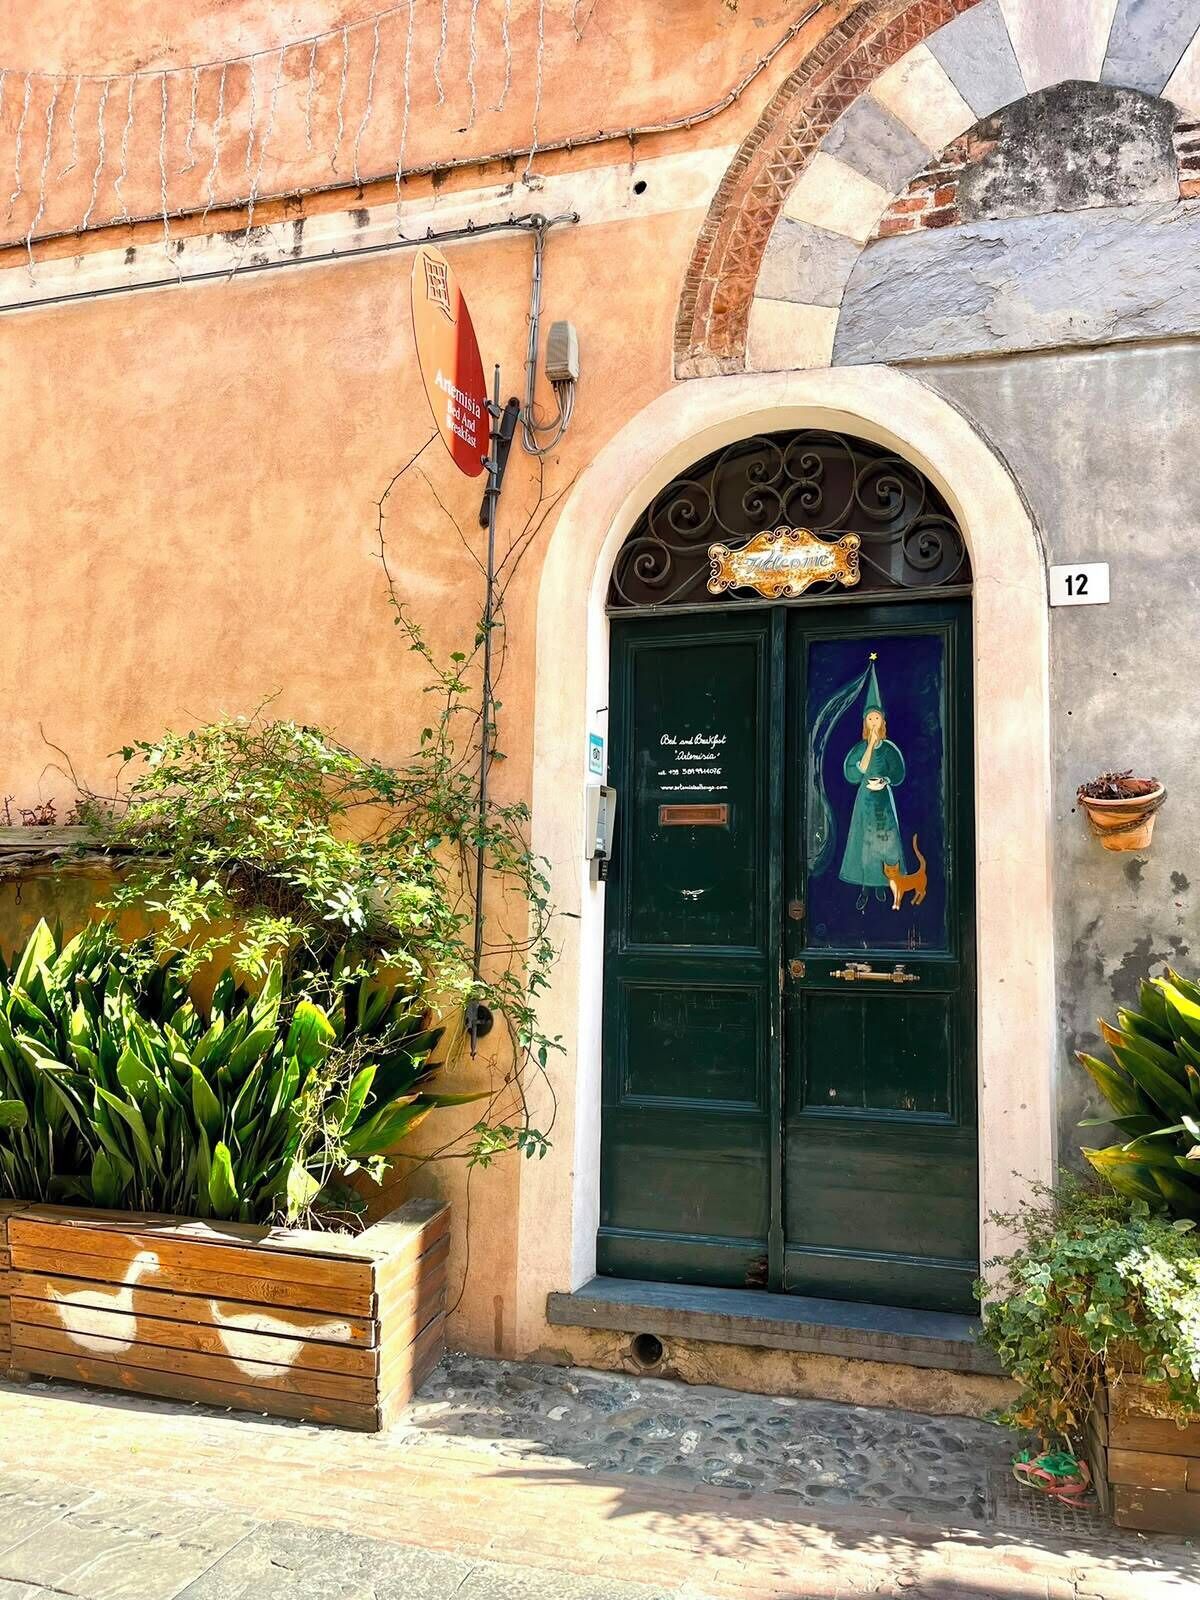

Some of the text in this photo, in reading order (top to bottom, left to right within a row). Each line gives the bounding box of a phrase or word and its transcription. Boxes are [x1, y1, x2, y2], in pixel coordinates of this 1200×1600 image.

[434, 368, 481, 419] Artemisia
[461, 413, 476, 433] And
[1065, 573, 1088, 595] 12
[660, 733, 677, 745] Bed
[679, 736, 693, 745] and
